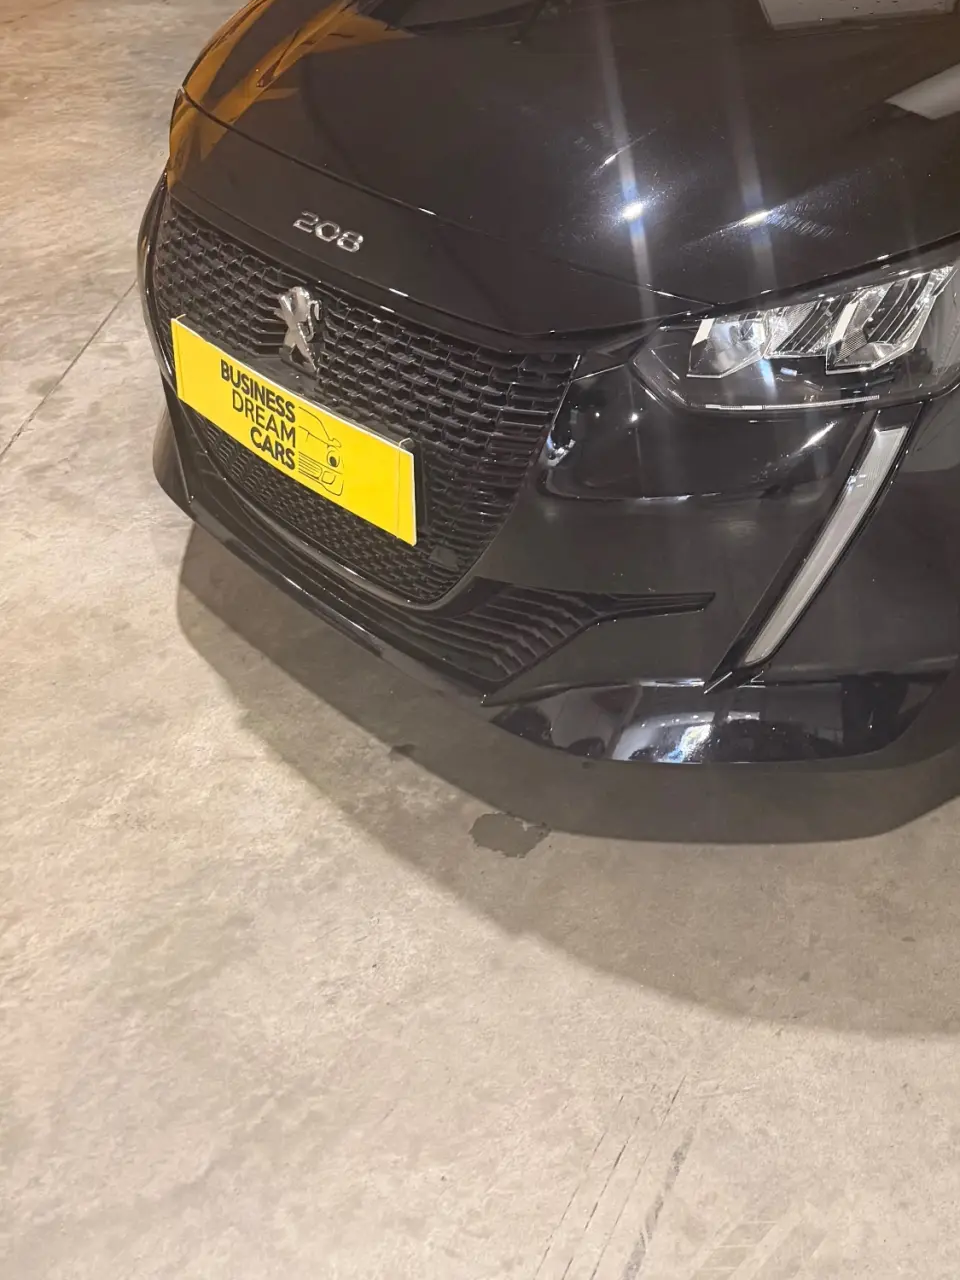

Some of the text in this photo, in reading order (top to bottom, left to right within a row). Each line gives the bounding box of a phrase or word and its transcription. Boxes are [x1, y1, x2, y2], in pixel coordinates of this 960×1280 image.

[292, 211, 364, 253] 208
[220, 358, 296, 424] BUSINESS
[232, 388, 296, 449] DREAM
[250, 426, 296, 471] CARS
